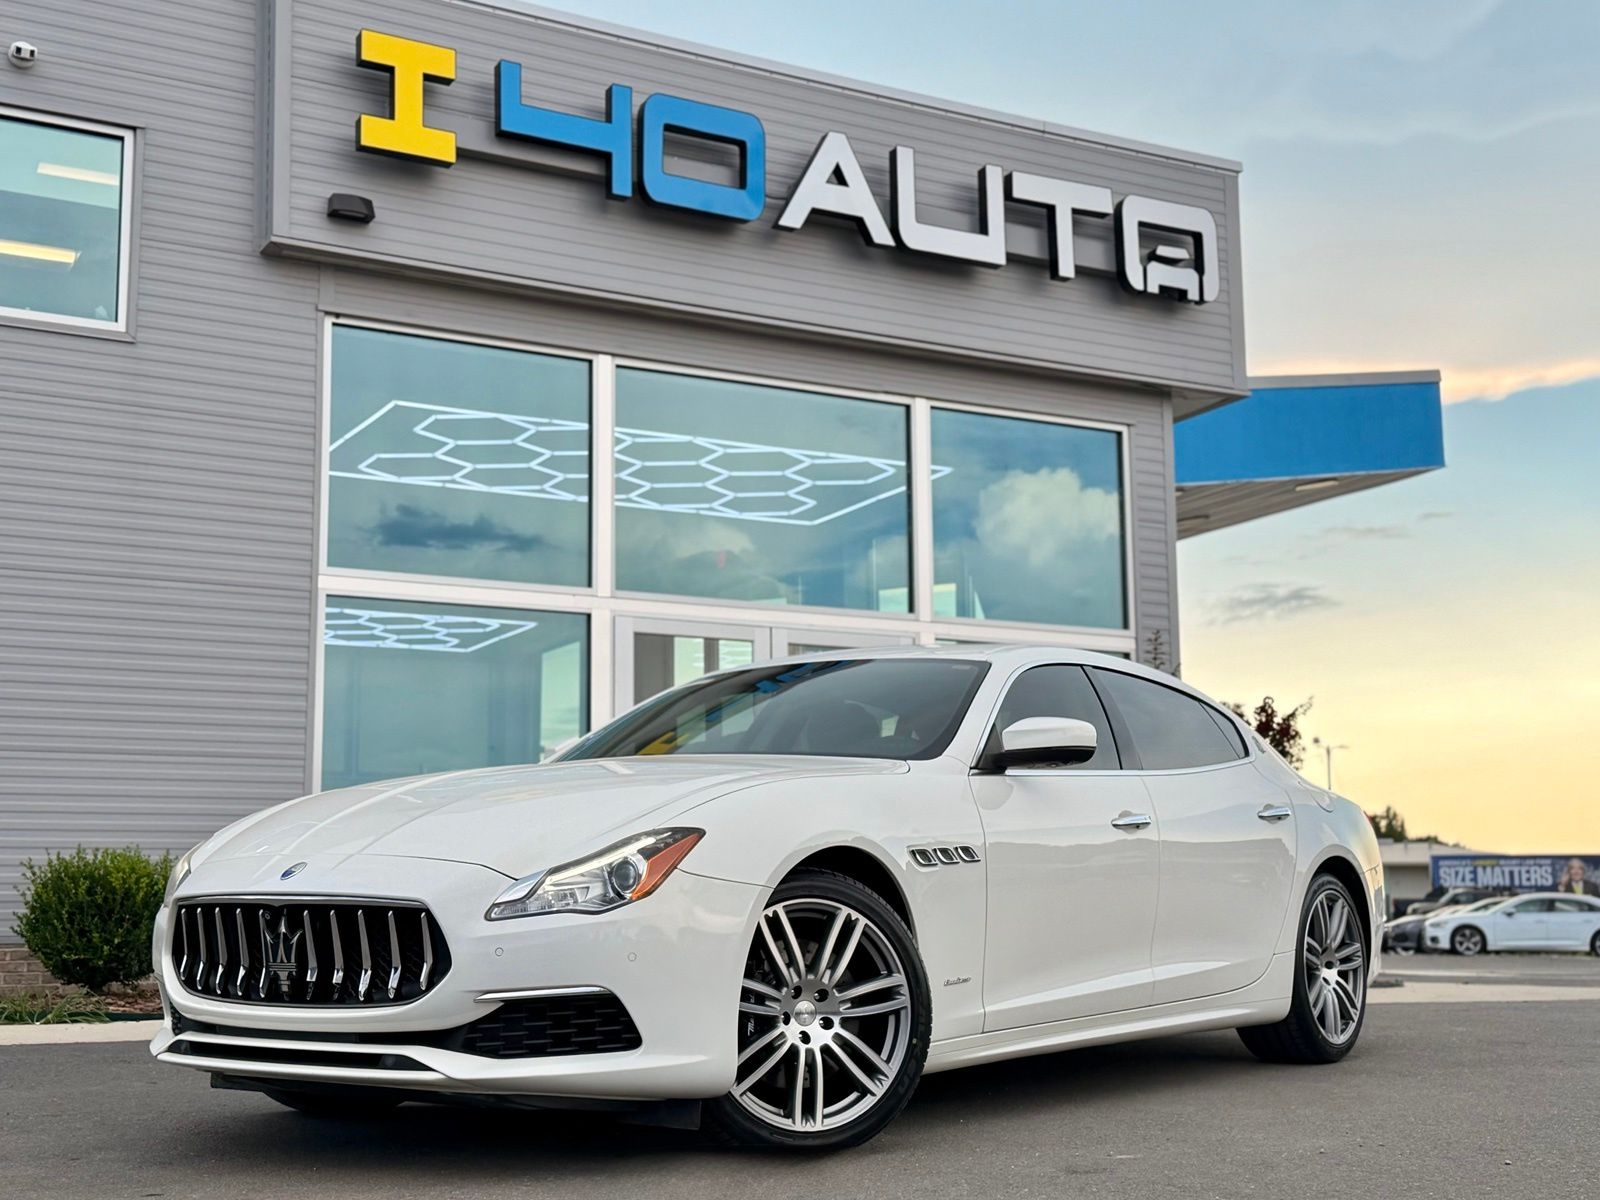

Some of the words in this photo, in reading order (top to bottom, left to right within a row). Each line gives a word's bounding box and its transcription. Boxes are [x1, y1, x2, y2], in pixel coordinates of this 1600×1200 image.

[776, 130, 1220, 303] AUTO
[1439, 866, 1475, 887] SIZE
[1477, 866, 1553, 887] MATTERS
